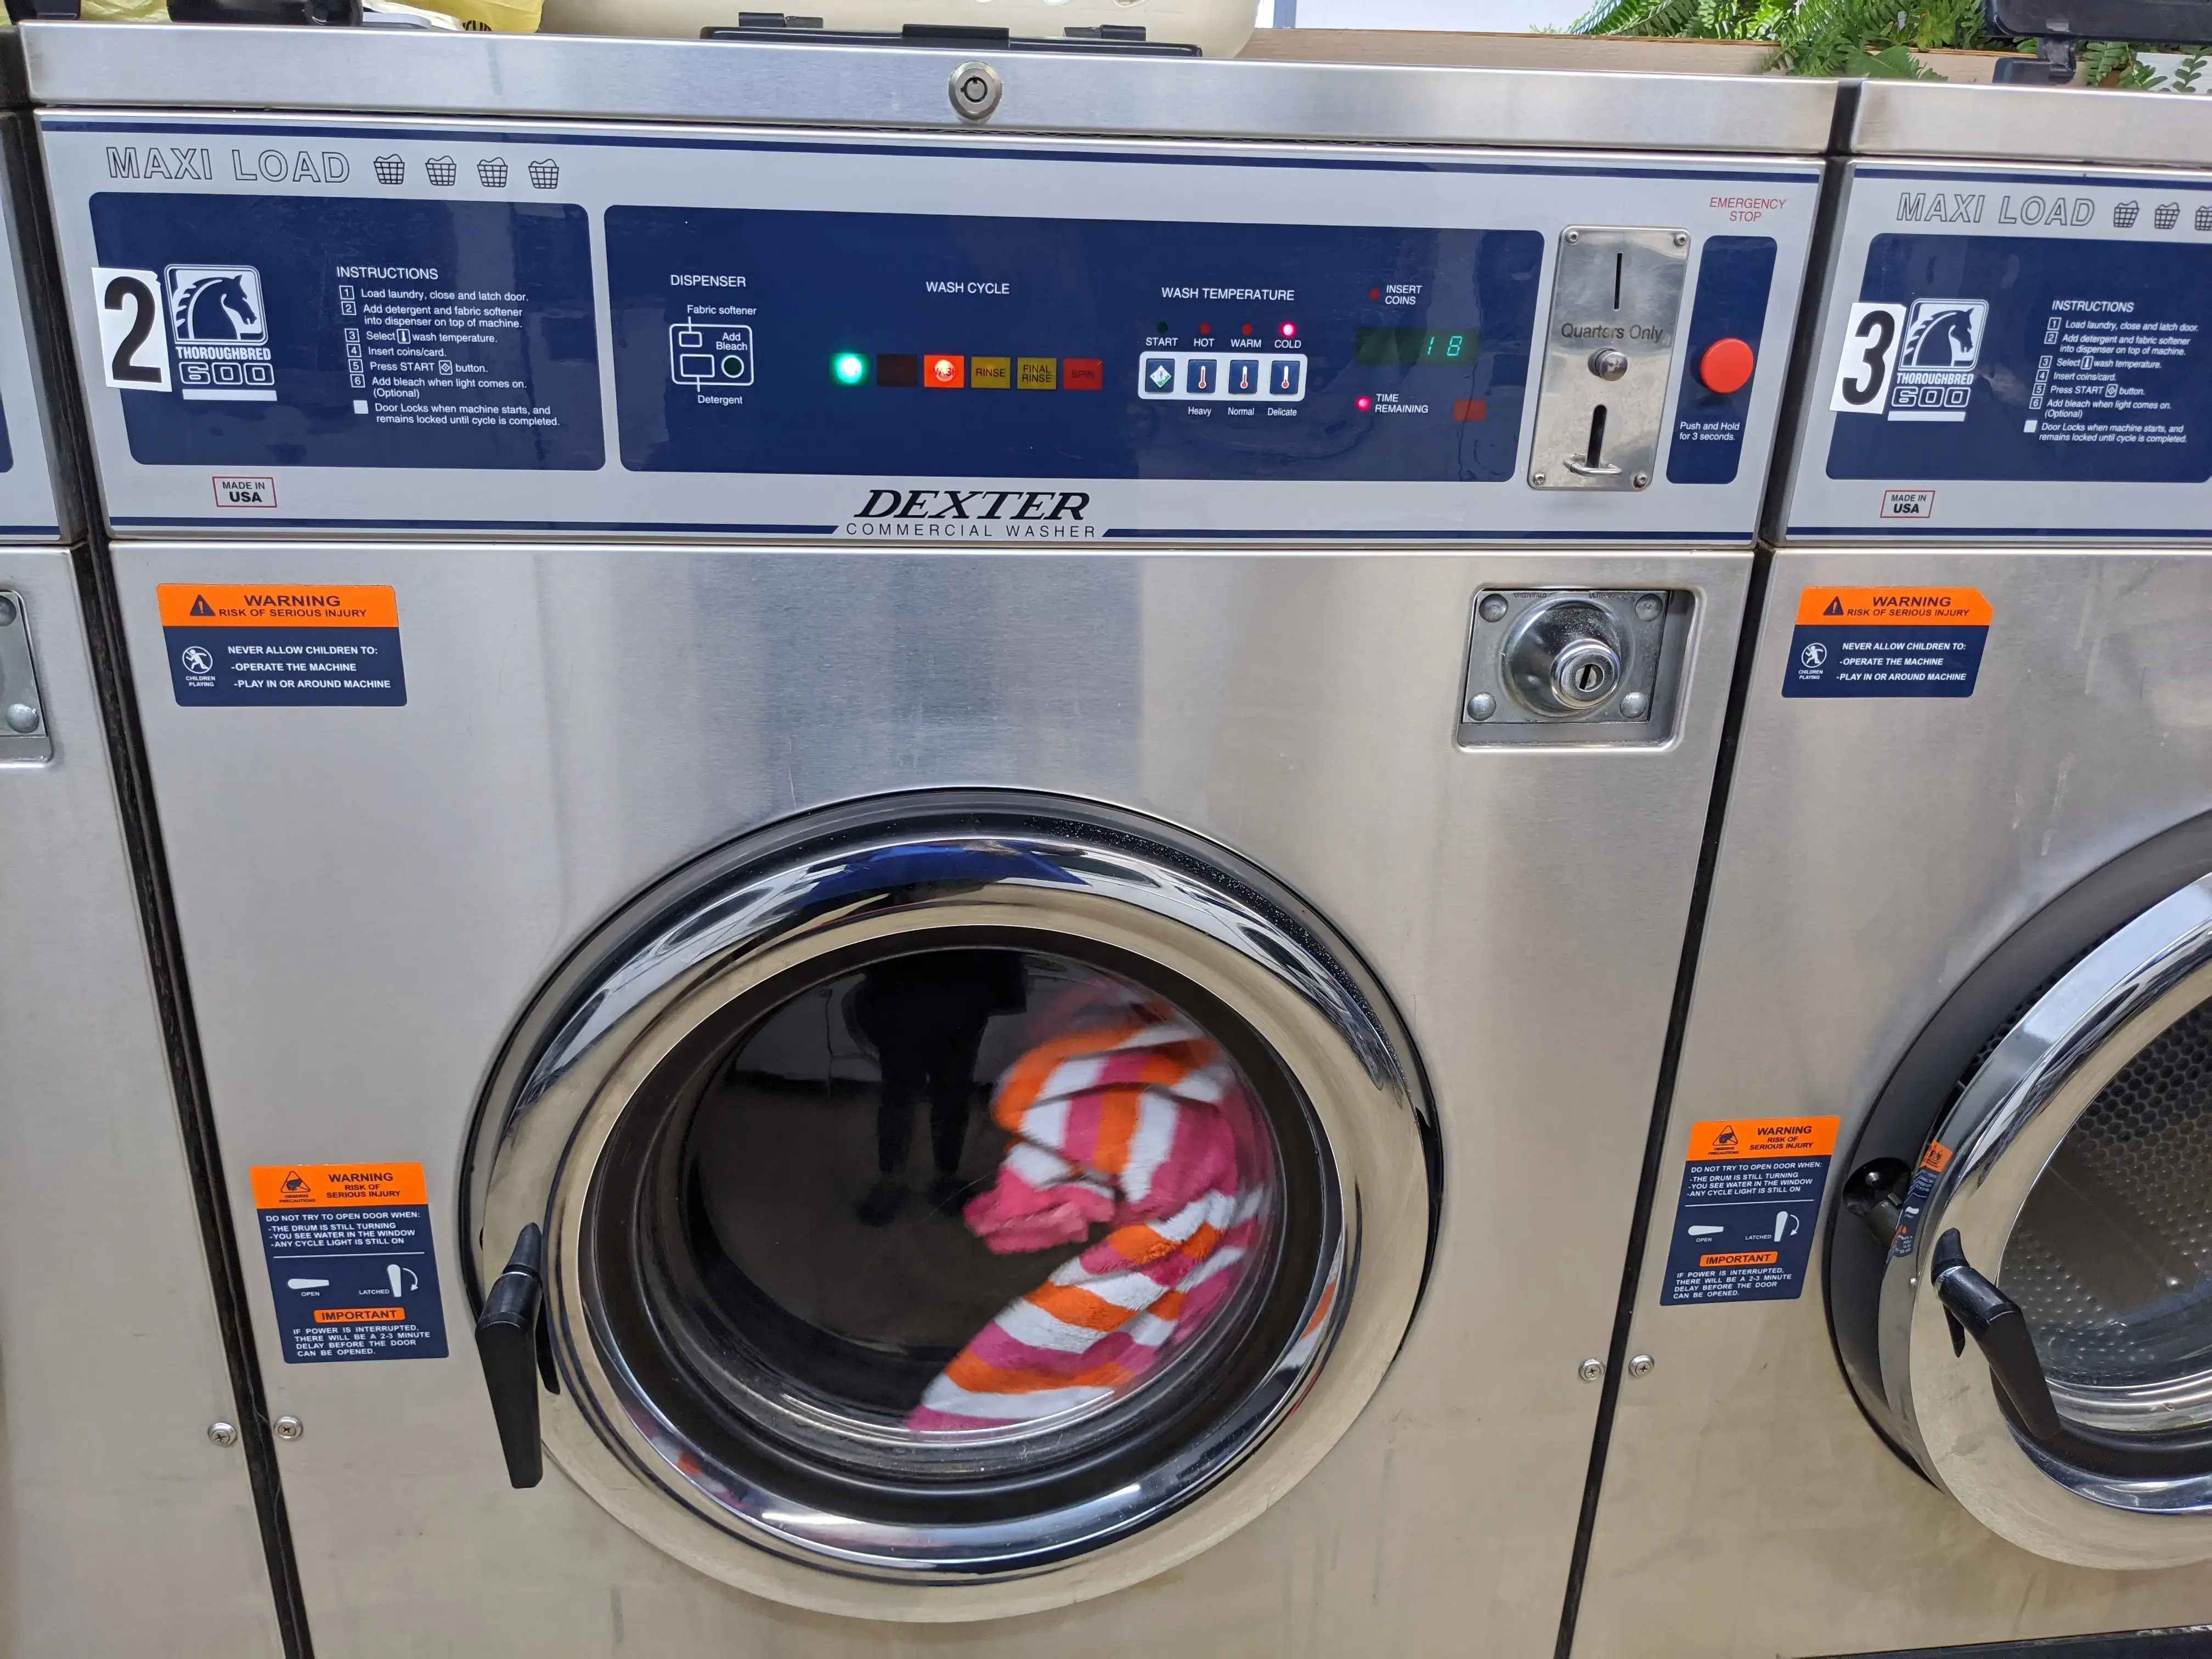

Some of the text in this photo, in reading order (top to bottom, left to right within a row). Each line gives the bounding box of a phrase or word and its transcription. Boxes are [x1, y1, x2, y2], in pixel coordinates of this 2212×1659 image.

[106, 147, 349, 183] MAXI LOAD
[1710, 198, 1786, 209] EMERGENCY
[1897, 193, 2095, 226] MAXI LOAD
[1730, 211, 1761, 222] STOP
[337, 267, 438, 279] INSTRUCTIONS
[671, 275, 746, 287] DISPENSER
[926, 281, 1009, 294] WASH CYCLE
[1387, 285, 1422, 294] INSERT
[344, 289, 528, 301] 1 Load laundry, close and latch door.
[1162, 287, 1295, 300] WASH TEMPERATURE
[1385, 296, 1415, 304] COINS
[346, 304, 522, 318] 2 Add detergent and fabric softener
[687, 305, 757, 315] Fabric softener
[2052, 300, 2134, 312] INSTRUCTIONS
[365, 316, 382, 325] into
[385, 316, 431, 327] dispenser
[449, 318, 464, 329] top
[467, 318, 476, 326] of
[479, 319, 522, 328] machine.
[104, 276, 162, 383] 2
[1561, 323, 1664, 343] Quarters Only
[349, 331, 497, 343] 3 Select wash temperature.
[723, 332, 741, 341] Add
[1146, 337, 1178, 346] START
[716, 341, 747, 351] Bleach
[1194, 338, 1215, 347] HOT
[1231, 339, 1261, 348] WARM
[1274, 340, 1301, 348] COLD
[176, 347, 271, 360] THOROUGHBRED
[351, 347, 447, 357] 4 Insert coins/card.
[1842, 310, 1896, 407] 3
[353, 362, 488, 372] 5 Press START button.
[976, 368, 1006, 377] RINSE
[1024, 365, 1051, 373] FINAL
[179, 362, 274, 385] 600
[1022, 374, 1052, 382] RINSE
[1071, 369, 1095, 379] SPIN
[1896, 372, 1974, 386] THOROUGHBRED
[355, 377, 362, 385] 6
[372, 377, 391, 385] Add
[393, 377, 425, 386] bleach
[427, 378, 453, 386] when
[456, 379, 476, 389] light
[374, 388, 419, 399] (Optional)
[1376, 394, 1398, 402] TIME
[1892, 386, 1971, 407] 600
[698, 395, 743, 406] Detergent
[375, 403, 550, 415] Door Locks when machine starts, and
[1188, 407, 1211, 417] Heavy
[1228, 407, 1254, 415] Normal
[1268, 408, 1297, 416] Delicate
[1375, 404, 1428, 413] REMAINING
[377, 415, 414, 423] remains
[416, 415, 447, 424] locked
[472, 416, 496, 426] cycle
[509, 417, 560, 427] completed.
[222, 481, 252, 490] MADE
[229, 492, 262, 502] USA
[1891, 494, 1916, 503] MADE
[853, 489, 1091, 521] DEXTER
[1894, 504, 1919, 513] USA
[847, 523, 1094, 537] COMMERCIAL WASHER
[244, 595, 340, 606] WARNING
[1874, 597, 1951, 607] WARNING
[1758, 1126, 1812, 1135] WARNING
[328, 1173, 393, 1182] WARNING
[1706, 1254, 1771, 1265] IMPORTANT
[321, 1310, 398, 1321] IMPORTANT
